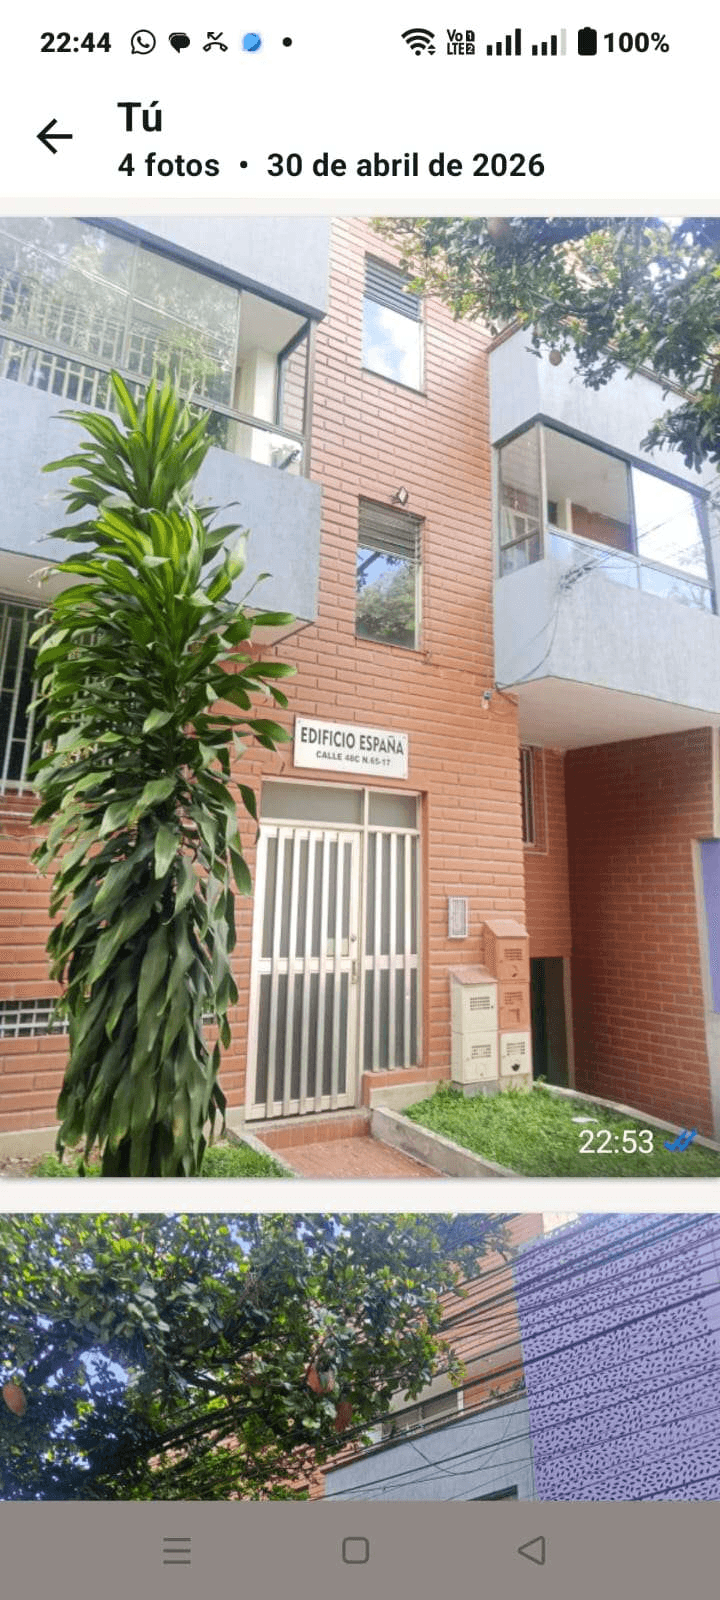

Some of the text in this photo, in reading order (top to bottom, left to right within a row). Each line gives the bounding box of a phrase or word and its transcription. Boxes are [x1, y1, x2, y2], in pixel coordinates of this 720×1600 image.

[40, 31, 112, 53] 22:44
[603, 31, 670, 53] 100%
[117, 100, 163, 133] Tú
[117, 152, 220, 177] 4 fotos
[267, 152, 545, 177] 30 de abril de 2026
[301, 726, 404, 755] EDIFICIO ESPAÑA
[316, 750, 342, 761] CALLE
